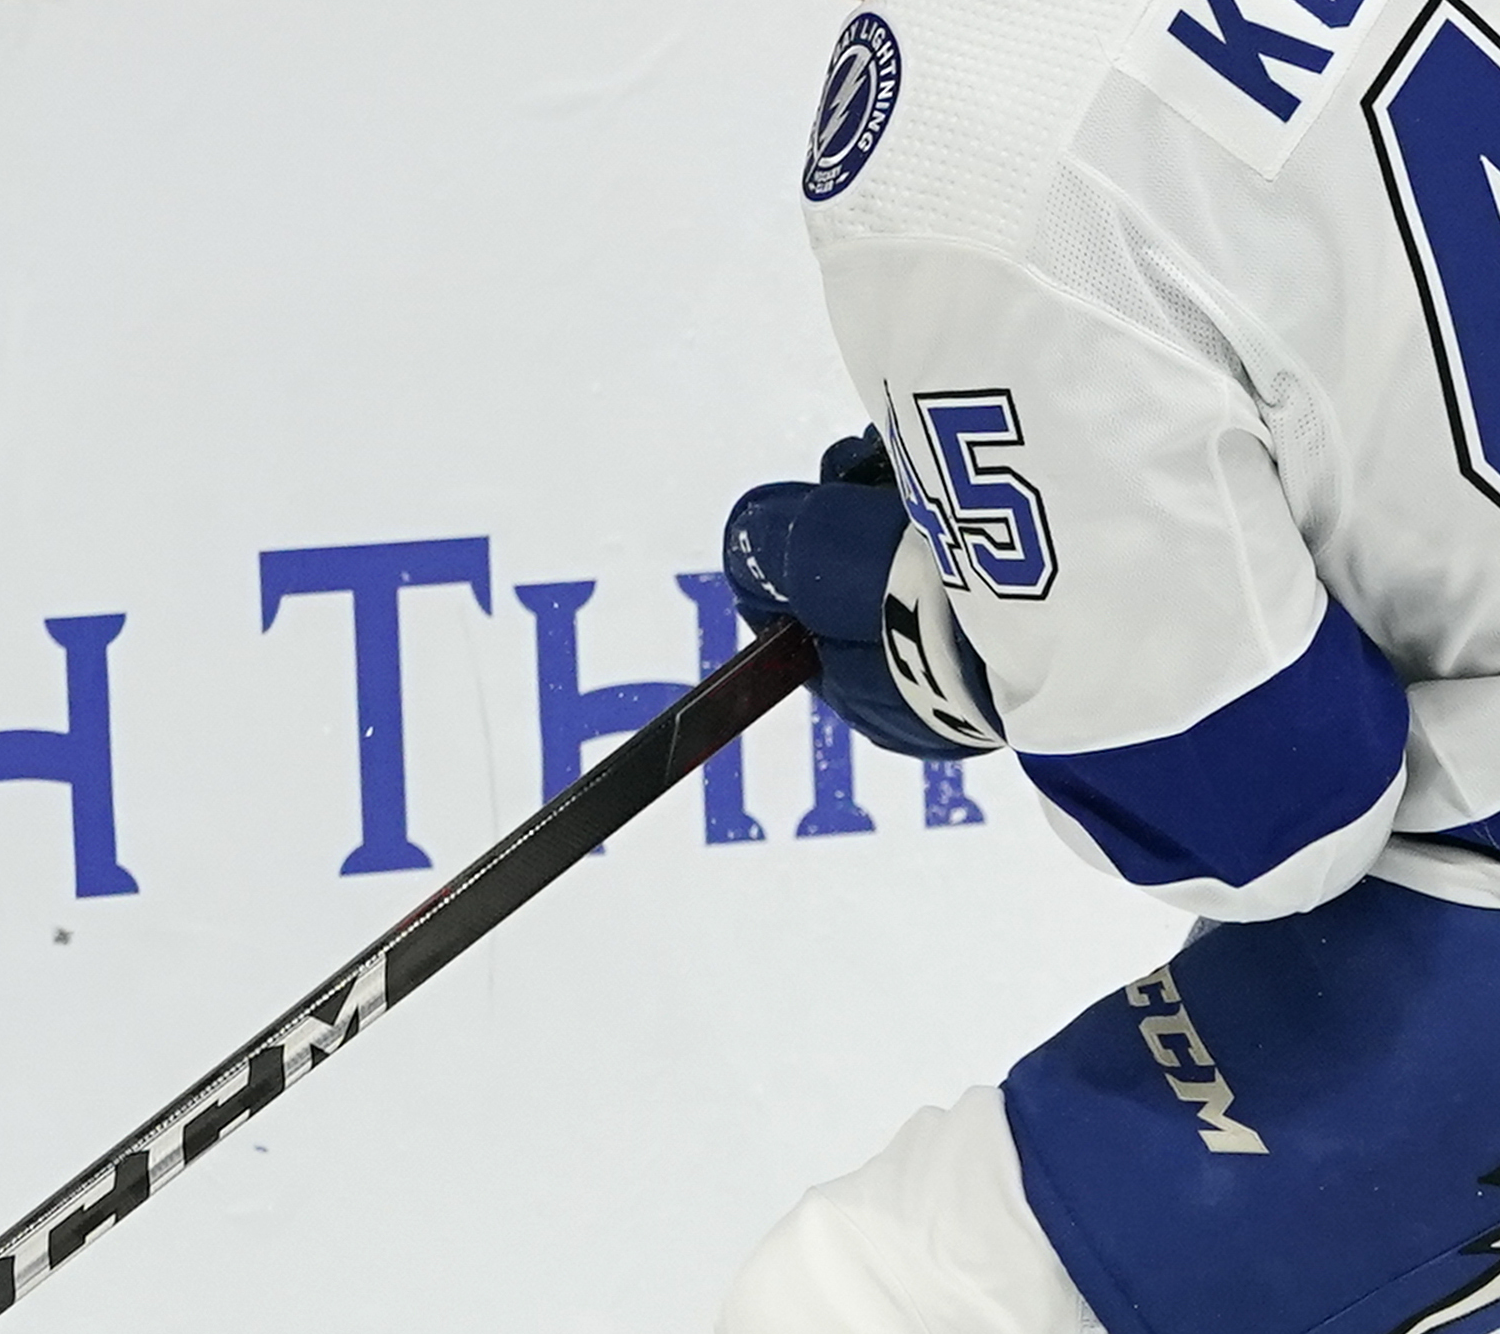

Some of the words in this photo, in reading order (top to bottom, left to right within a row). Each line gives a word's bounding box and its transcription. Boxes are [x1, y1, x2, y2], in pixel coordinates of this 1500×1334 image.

[858, 19, 897, 153] LIGHTNING
[884, 378, 1059, 601] 45
[1124, 965, 1270, 1154] CCM
